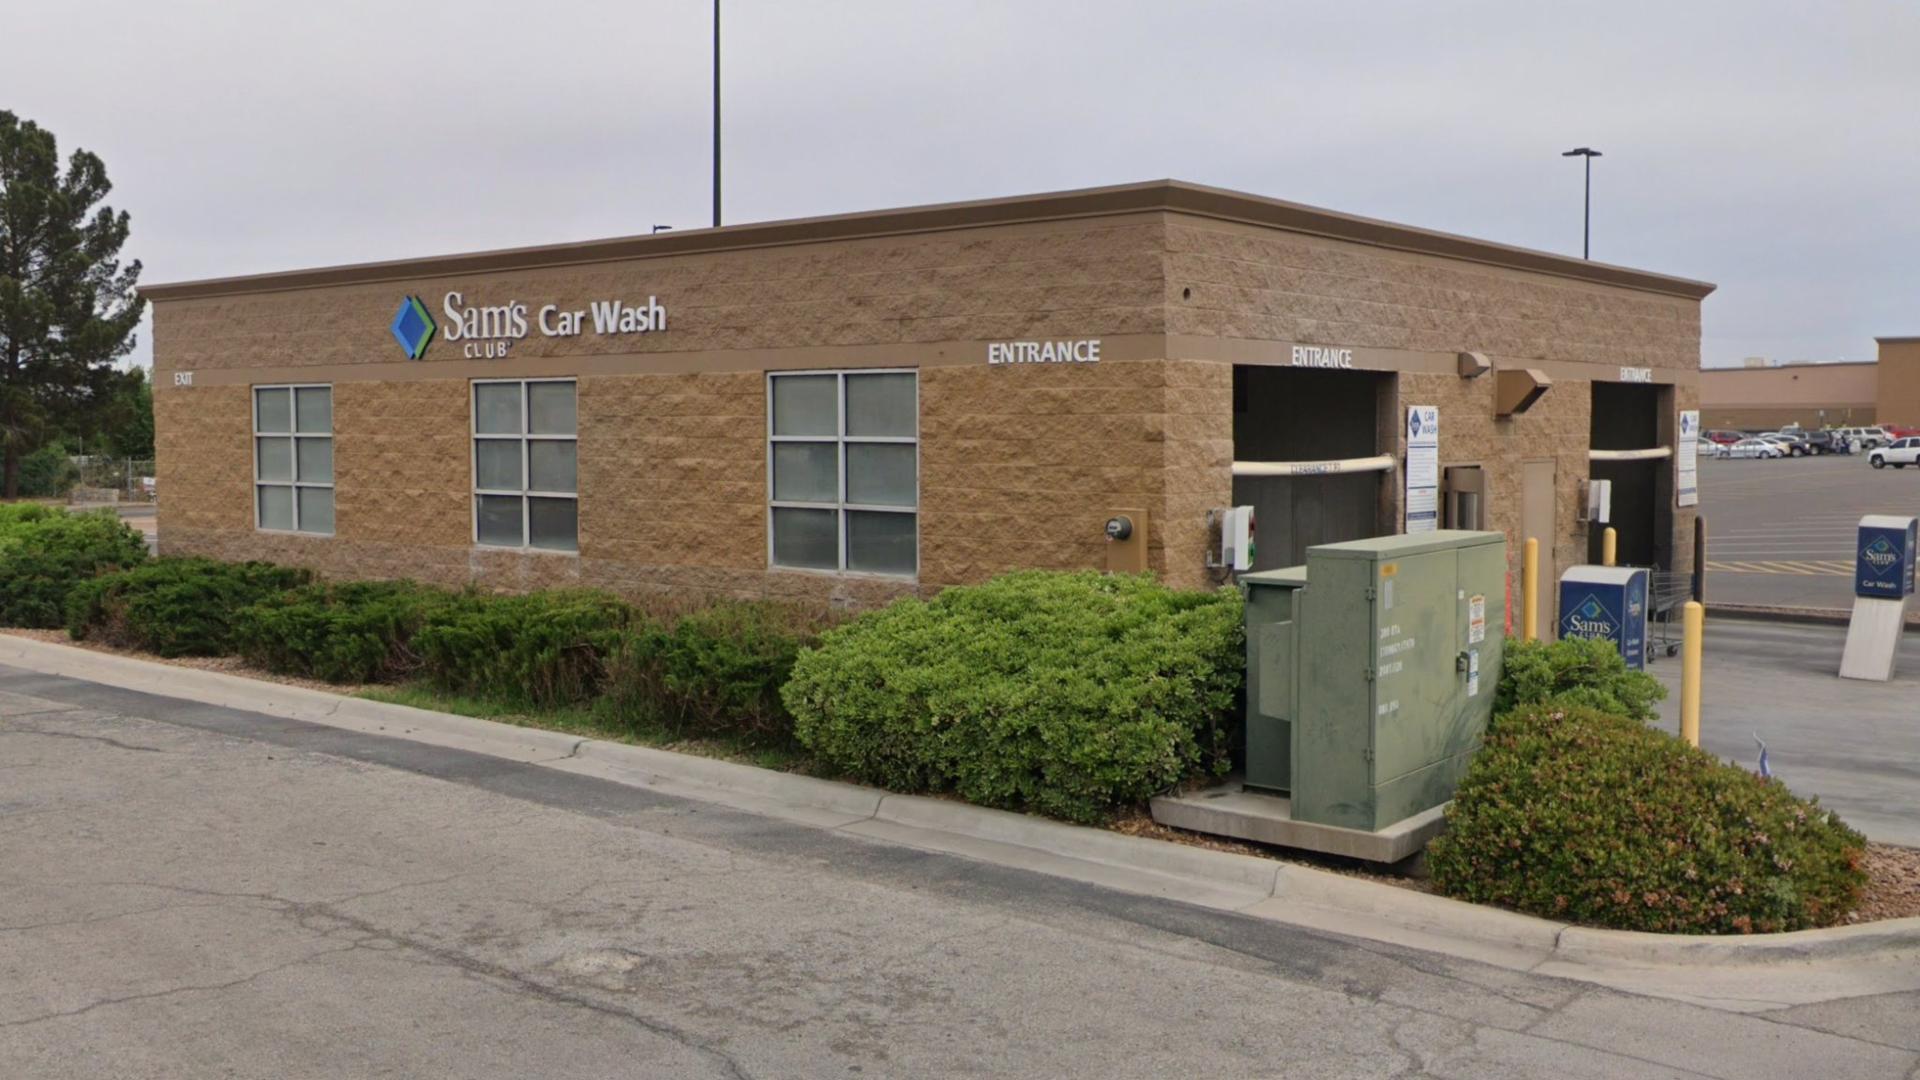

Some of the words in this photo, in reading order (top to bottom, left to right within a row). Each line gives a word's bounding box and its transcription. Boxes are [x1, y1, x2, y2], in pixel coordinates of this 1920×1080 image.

[444, 291, 528, 341] Sam's
[538, 304, 585, 337] Car
[591, 295, 667, 335] Wash
[987, 340, 1101, 364] ENTRANCE
[1292, 345, 1353, 368] ENTRANCE
[174, 371, 193, 386] EXIT
[1620, 367, 1652, 383] ENTRANCE
[1863, 580, 1875, 588] Car
[1876, 581, 1897, 589] Wash
[1570, 614, 1611, 633] Sam's
